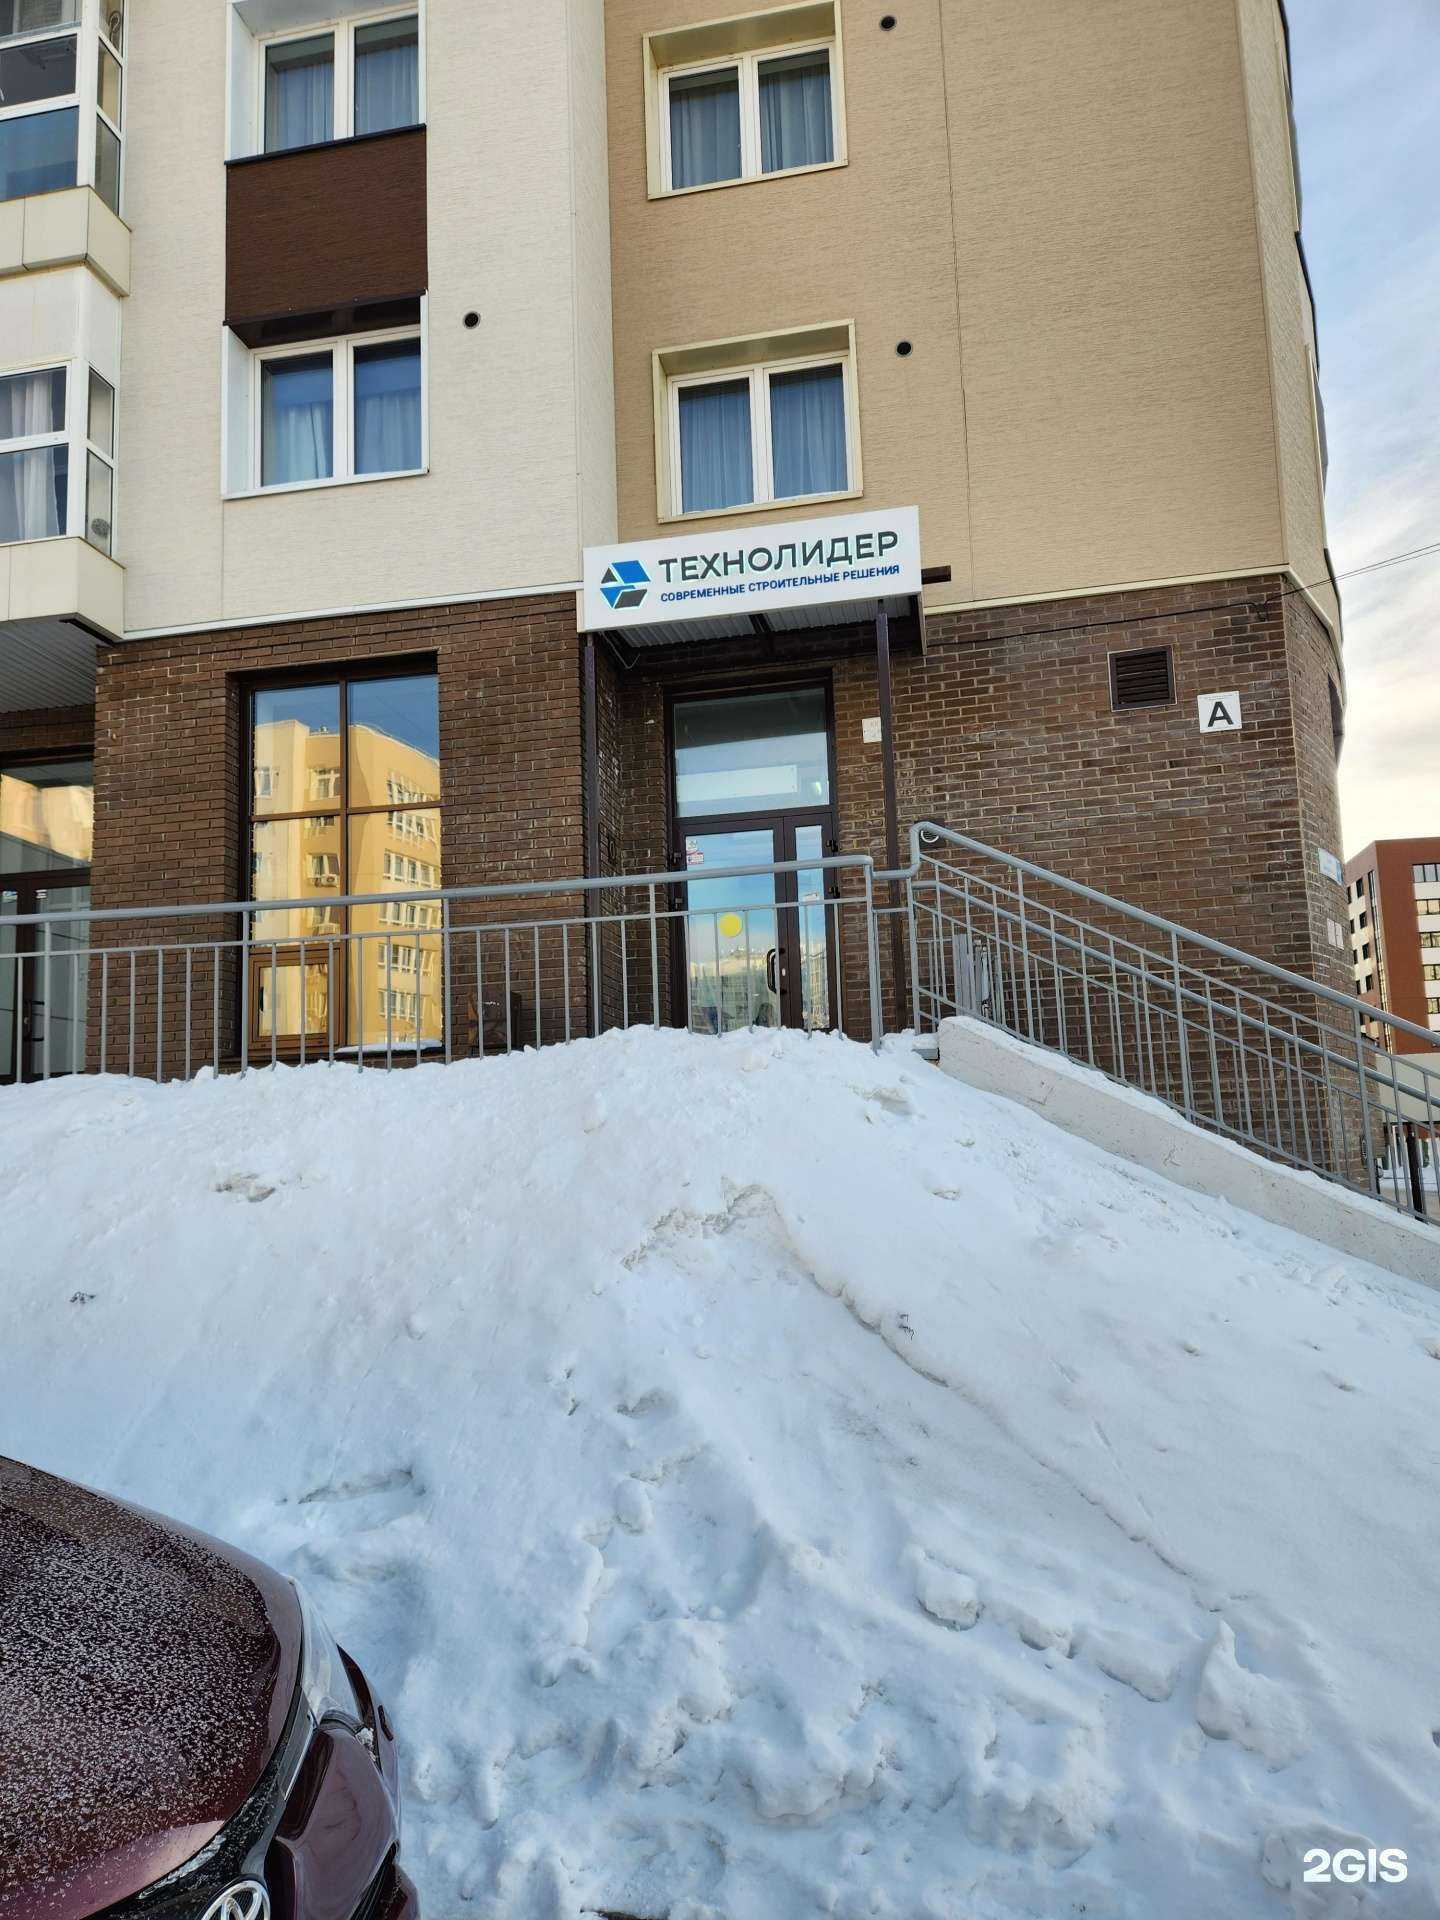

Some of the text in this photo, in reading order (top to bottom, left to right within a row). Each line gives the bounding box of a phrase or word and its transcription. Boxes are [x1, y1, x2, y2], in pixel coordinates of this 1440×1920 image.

[658, 530, 898, 583] ТЕХНОЛИДЕР
[660, 564, 900, 602] СОВРЕМЕННЫЕ СТРОИТЕЛЬНЫЕ РЕШЕНИЯ
[1207, 701, 1234, 727] А
